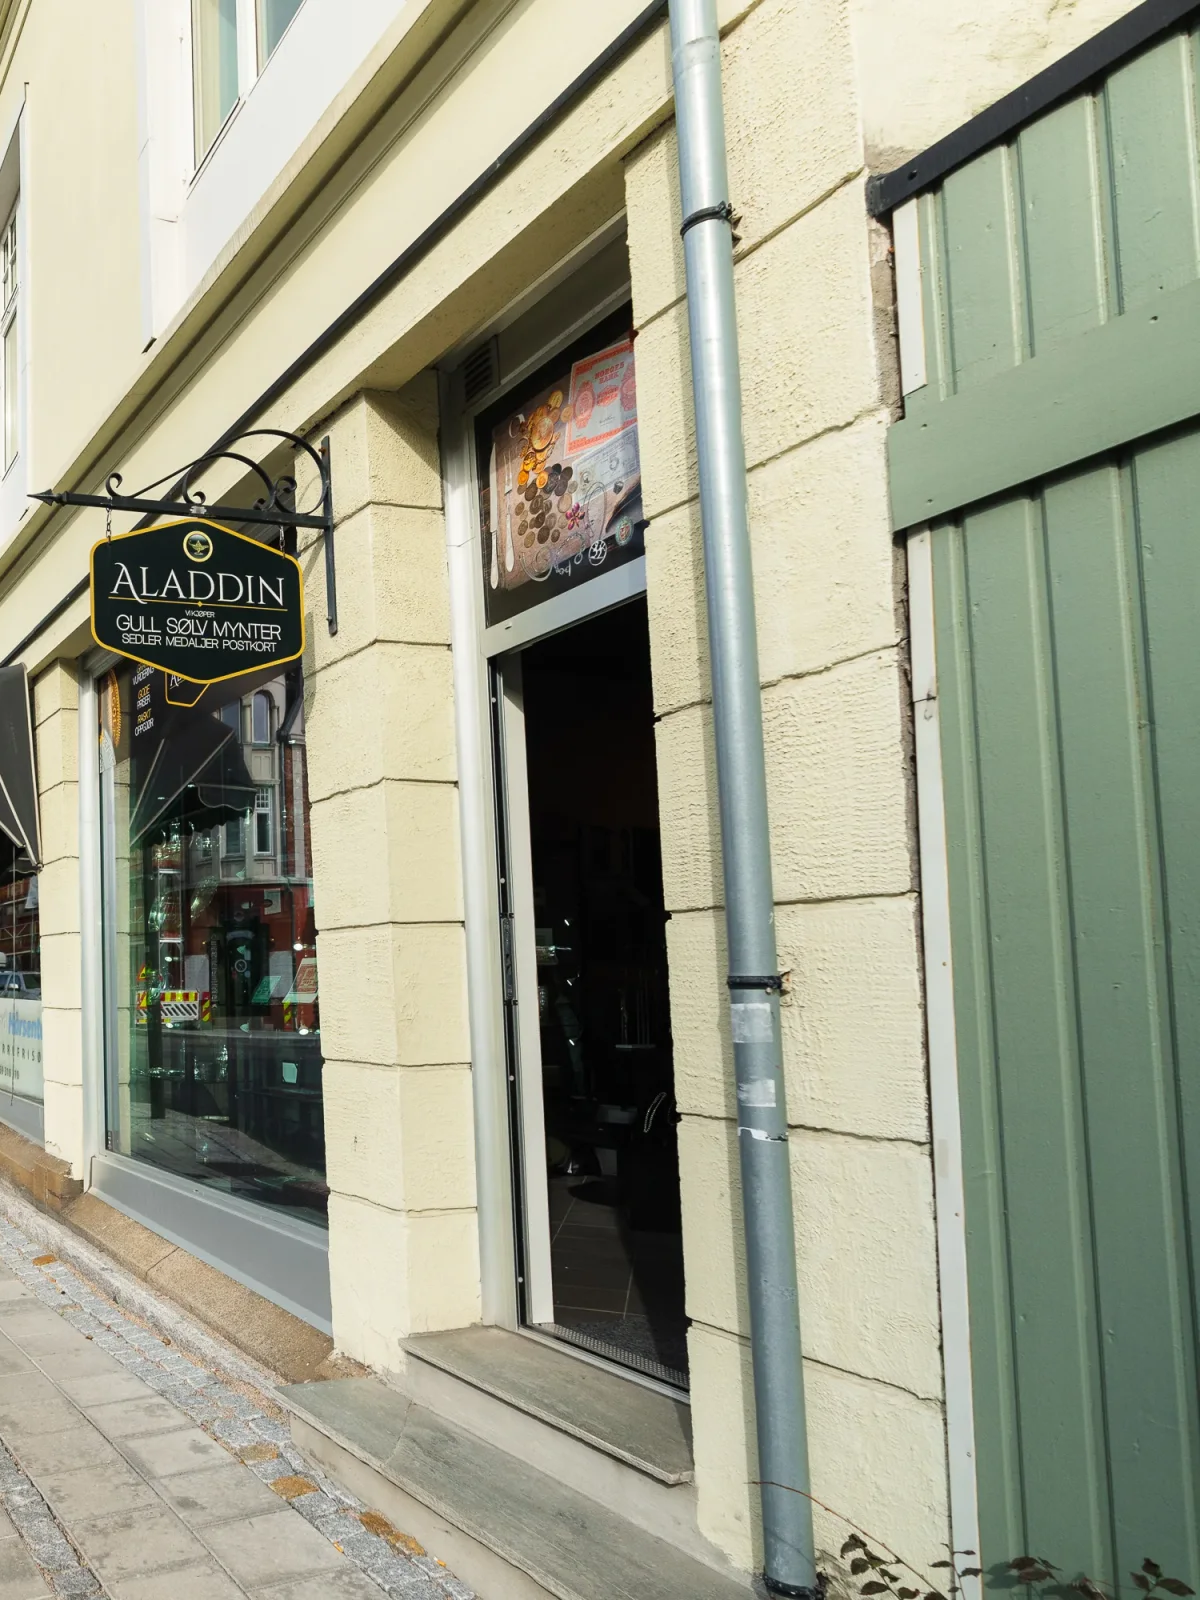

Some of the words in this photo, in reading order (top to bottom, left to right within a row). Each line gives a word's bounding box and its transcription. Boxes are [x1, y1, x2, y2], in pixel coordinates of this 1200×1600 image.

[110, 562, 284, 606] ALADDIN
[116, 614, 161, 632] GULL
[166, 617, 208, 636] SØLV
[213, 620, 281, 640] MYNTER
[121, 633, 161, 645] SEDLER
[166, 636, 219, 649] MEDALJER
[222, 640, 277, 652] POSTKORT
